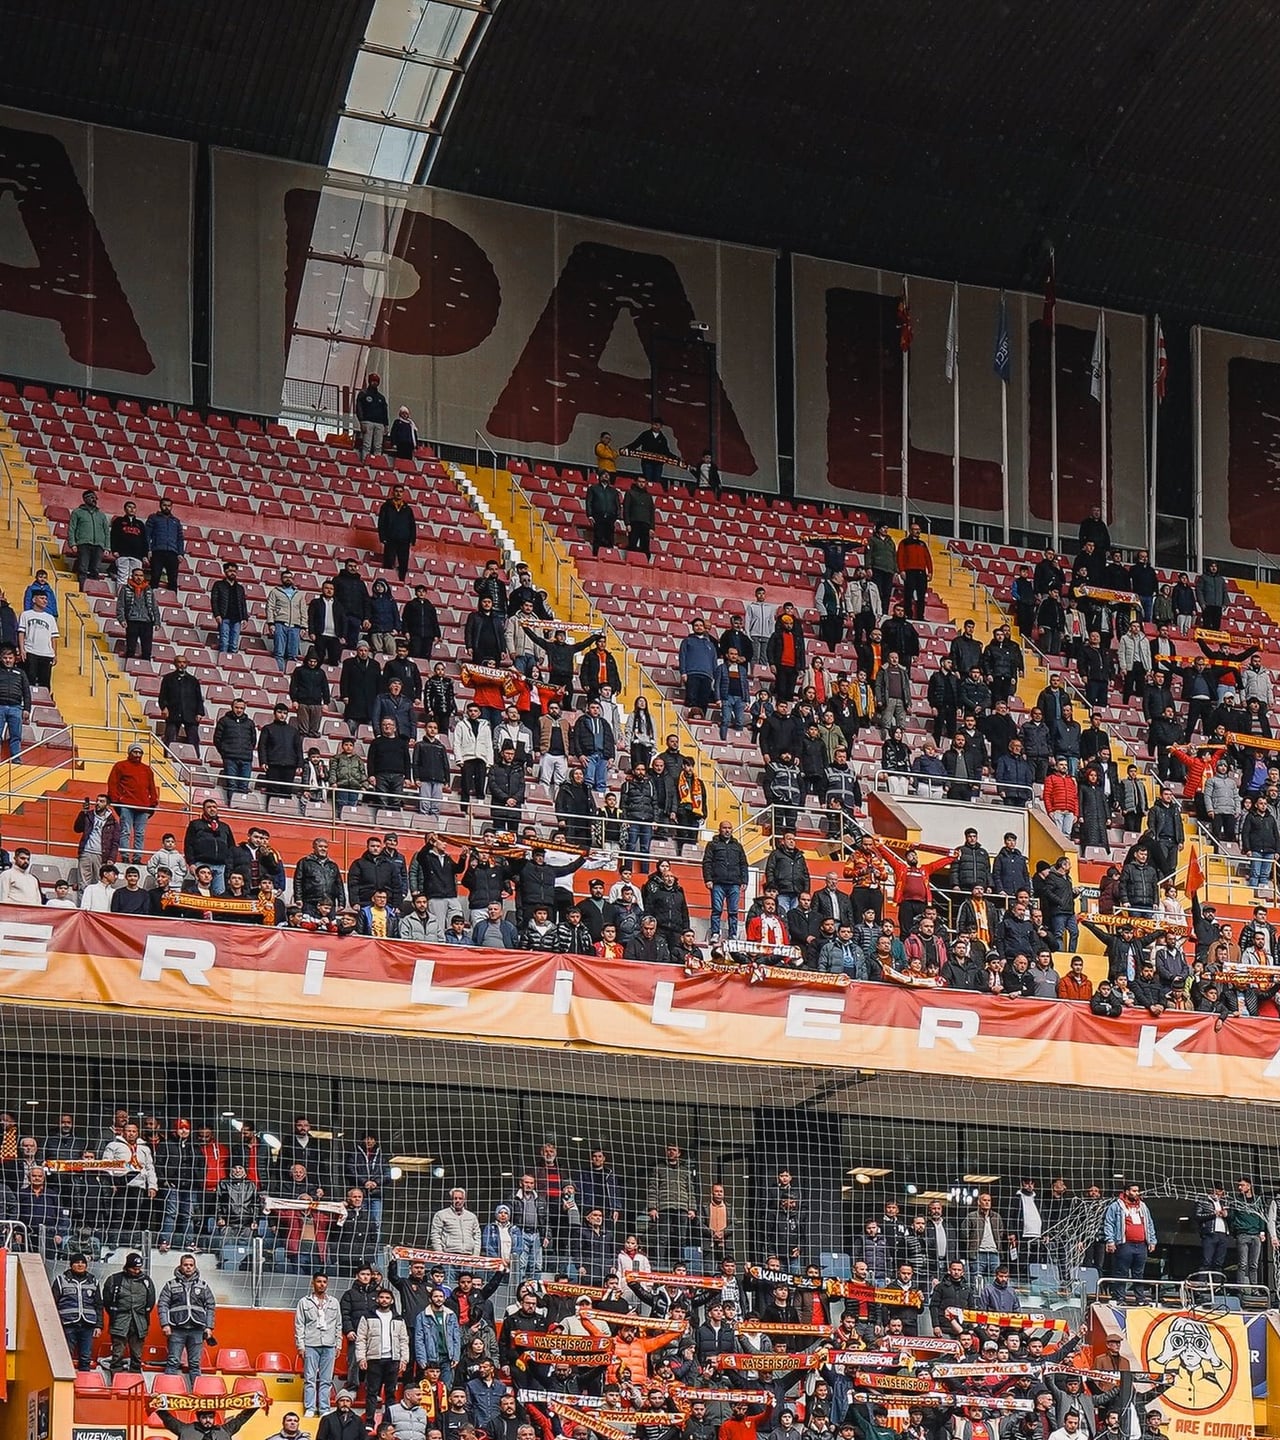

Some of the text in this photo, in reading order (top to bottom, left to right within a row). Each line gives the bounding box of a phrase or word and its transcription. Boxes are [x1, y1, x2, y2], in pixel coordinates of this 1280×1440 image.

[534, 1335, 594, 1351] KAYSERİSPOR
[892, 1337, 956, 1352] KAYSERİSPOR
[538, 1352, 611, 1365] KAYSERİSPOR
[742, 1357, 799, 1371] KAYSERİSPOR
[835, 1353, 892, 1366] KAYSERİSPOR
[878, 1377, 929, 1391] KAYSERİSPOR
[170, 1396, 251, 1411] KAYSERİSPOR
[682, 1391, 766, 1404] KAYSERİSPOR
[1175, 1419, 1252, 1440] ARE COMING
